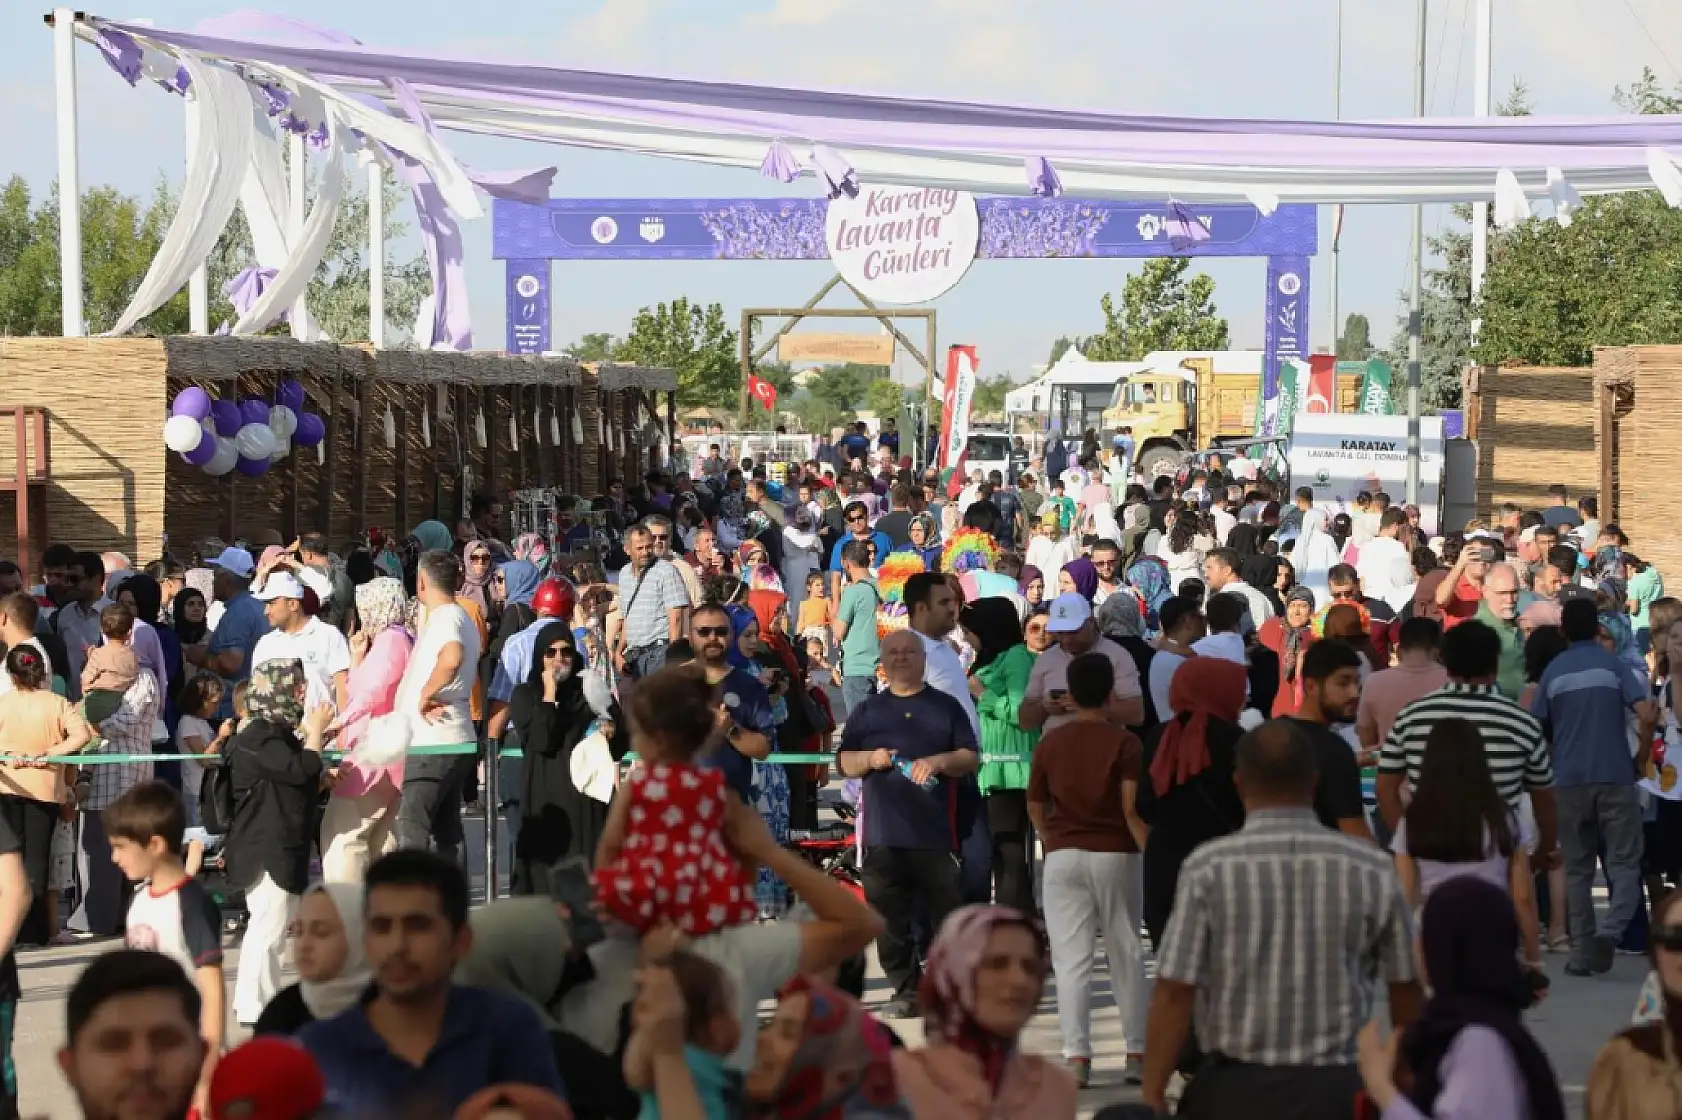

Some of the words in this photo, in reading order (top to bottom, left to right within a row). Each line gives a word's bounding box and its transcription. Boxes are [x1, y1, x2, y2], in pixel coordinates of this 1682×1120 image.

[864, 187, 958, 218] Karatay
[835, 212, 942, 251] Lavanta
[863, 241, 953, 281] Günleri
[1341, 440, 1397, 452] KARATAY
